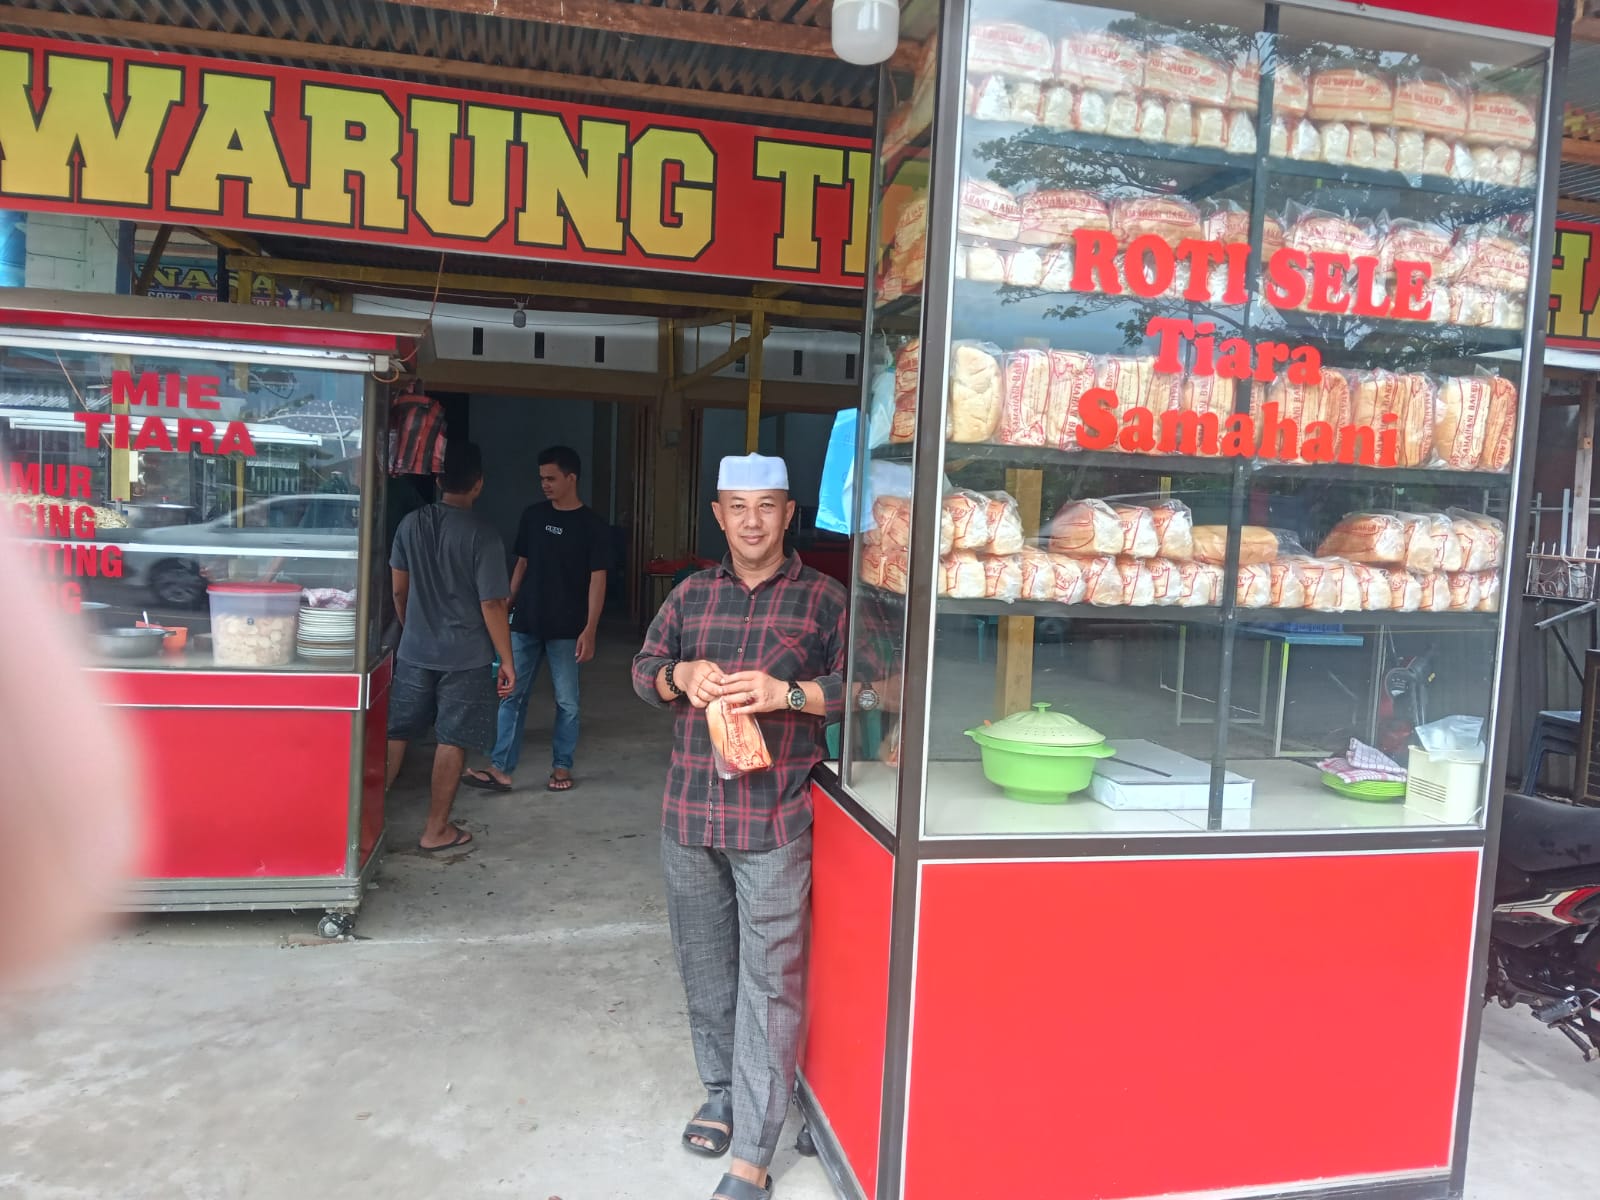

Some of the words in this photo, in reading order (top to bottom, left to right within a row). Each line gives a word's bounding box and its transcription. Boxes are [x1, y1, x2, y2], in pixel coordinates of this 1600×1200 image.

[0, 47, 718, 262] WARUNG
[1070, 229, 1250, 304] ROTI
[1266, 247, 1432, 321] SELE
[1146, 316, 1321, 385] Tiara
[111, 370, 221, 410] MIE
[74, 411, 257, 457] TIARA
[1076, 388, 1399, 467] Samahani
